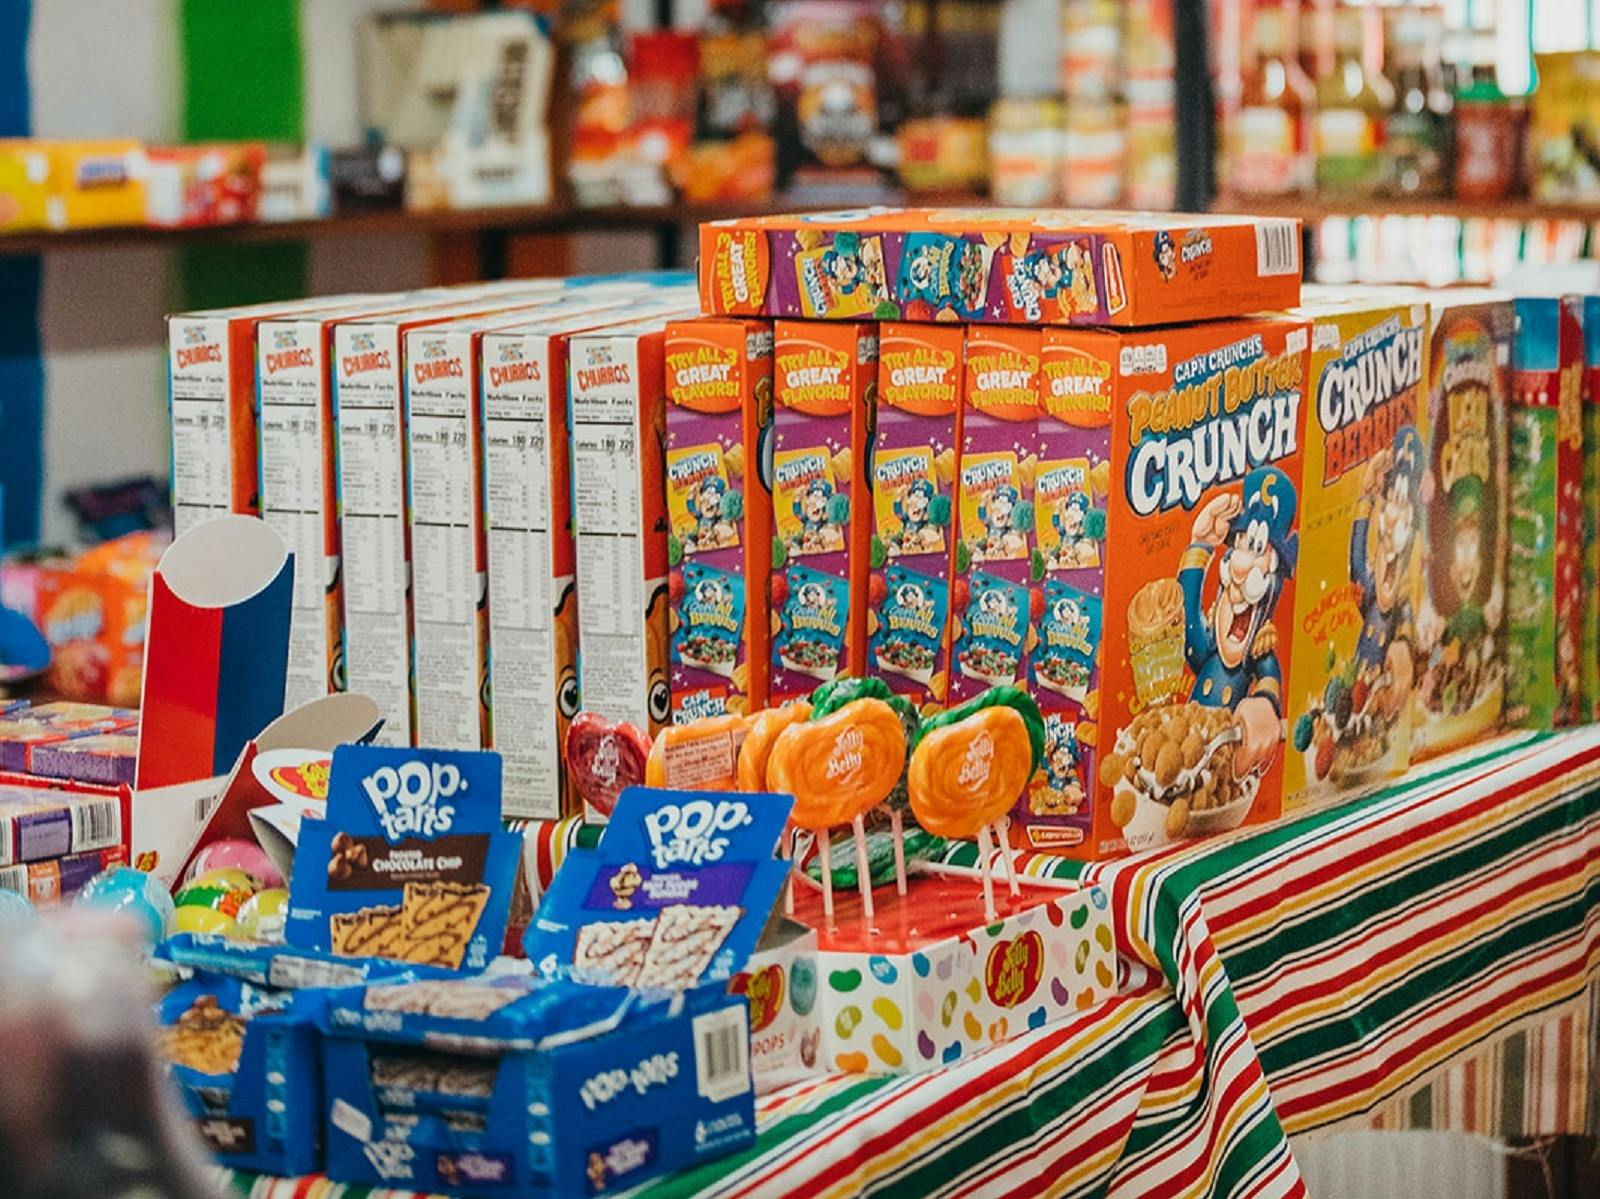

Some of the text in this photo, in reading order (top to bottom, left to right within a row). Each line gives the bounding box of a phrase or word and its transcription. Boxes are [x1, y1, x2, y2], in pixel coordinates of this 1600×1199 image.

[717, 233, 736, 313] TRY ALL 3
[730, 240, 748, 302] GREAT
[744, 231, 763, 308] FLAVORS!
[413, 358, 463, 384] CHURROS
[666, 347, 737, 370] TRY ALL 3
[777, 349, 849, 372] TRY ALL 3
[881, 348, 955, 370] TRY ALL 3
[968, 352, 1040, 374] TRY ALL 3
[1041, 358, 1111, 380] TRY ALL 3
[489, 360, 541, 388] CHURROS
[576, 364, 631, 392] CHURROS
[676, 364, 731, 388] GREAT
[786, 367, 842, 389] GREAT
[891, 367, 947, 387] GREAT
[977, 371, 1032, 391] GREAT
[1051, 376, 1103, 397] GREAT
[1319, 329, 1424, 433] CRUNCH
[672, 382, 739, 404] FLAVORS!
[781, 385, 849, 406] FLAVORS!
[1127, 353, 1303, 447] PEANUT BUTTER
[1323, 391, 1418, 488] BERRIES
[668, 452, 718, 480] CRUNCH
[1129, 393, 1300, 516] CRUNCH
[776, 455, 826, 482] CRUNCH
[876, 456, 928, 482] CRUNCH
[962, 460, 1012, 486] CRUNCH
[1037, 468, 1085, 493] CRUNCH
[826, 750, 863, 779] Belly
[381, 803, 455, 840] tarts
[373, 855, 463, 873] CHOCOLATE CHIP
[651, 836, 730, 869] tarts
